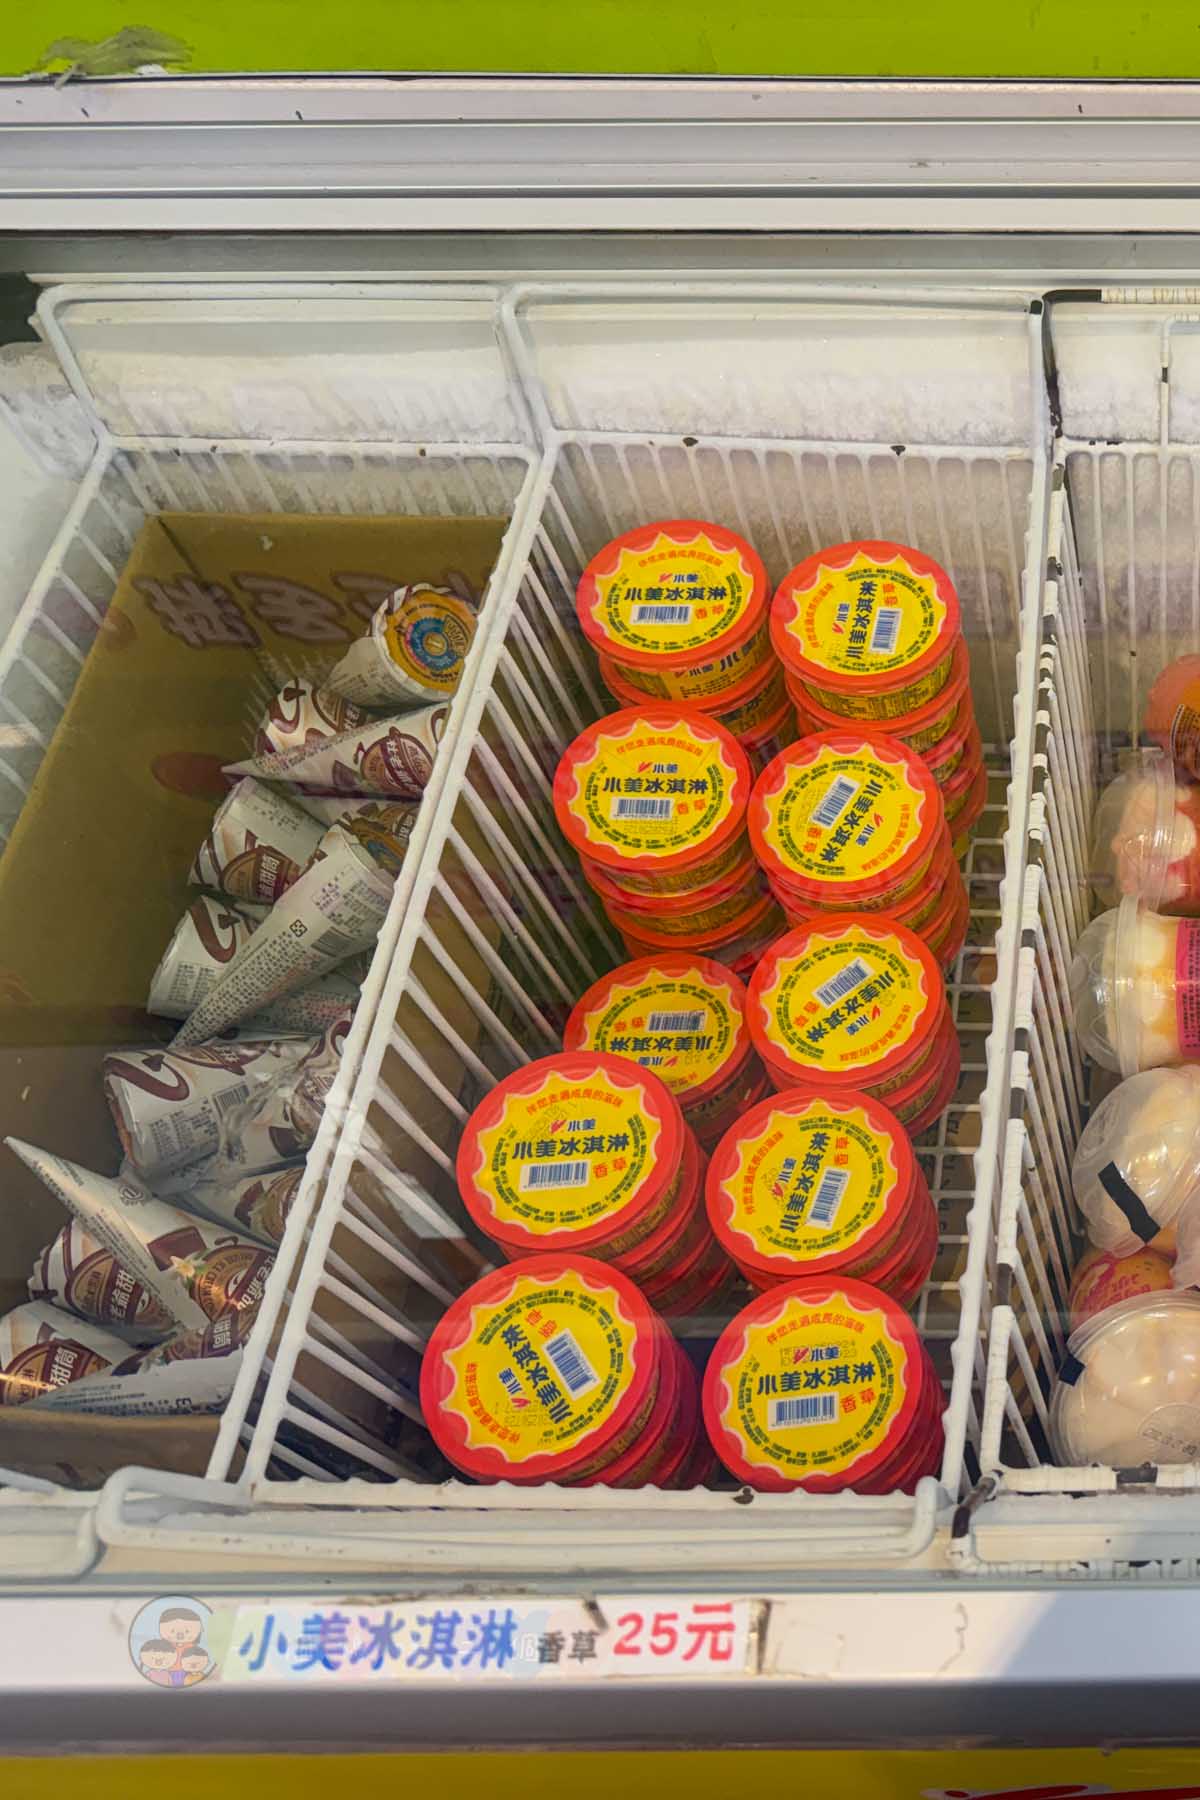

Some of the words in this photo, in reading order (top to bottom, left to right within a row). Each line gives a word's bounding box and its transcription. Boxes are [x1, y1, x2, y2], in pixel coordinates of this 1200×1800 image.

[624, 587, 727, 601] 小美冰淇淋
[845, 581, 877, 659] 小美冰淇淋
[602, 777, 708, 794] 小美冰淇淋
[820, 780, 883, 862] 小美冰淇淋
[807, 971, 894, 1042] 小美冰淇淋
[610, 1036, 713, 1052] 小美冰淇淋
[512, 1133, 630, 1160] 小美冰淇淋
[780, 1132, 830, 1233] 小美冰淇淋
[501, 1324, 573, 1424] 小美冰淇淋
[757, 1361, 875, 1395] 小美冰淇淋
[810, 1347, 840, 1362] 小美
[239, 1608, 518, 1671] 小美冰淇淋
[538, 1629, 599, 1664] 香草
[613, 1602, 736, 1662] 25元
